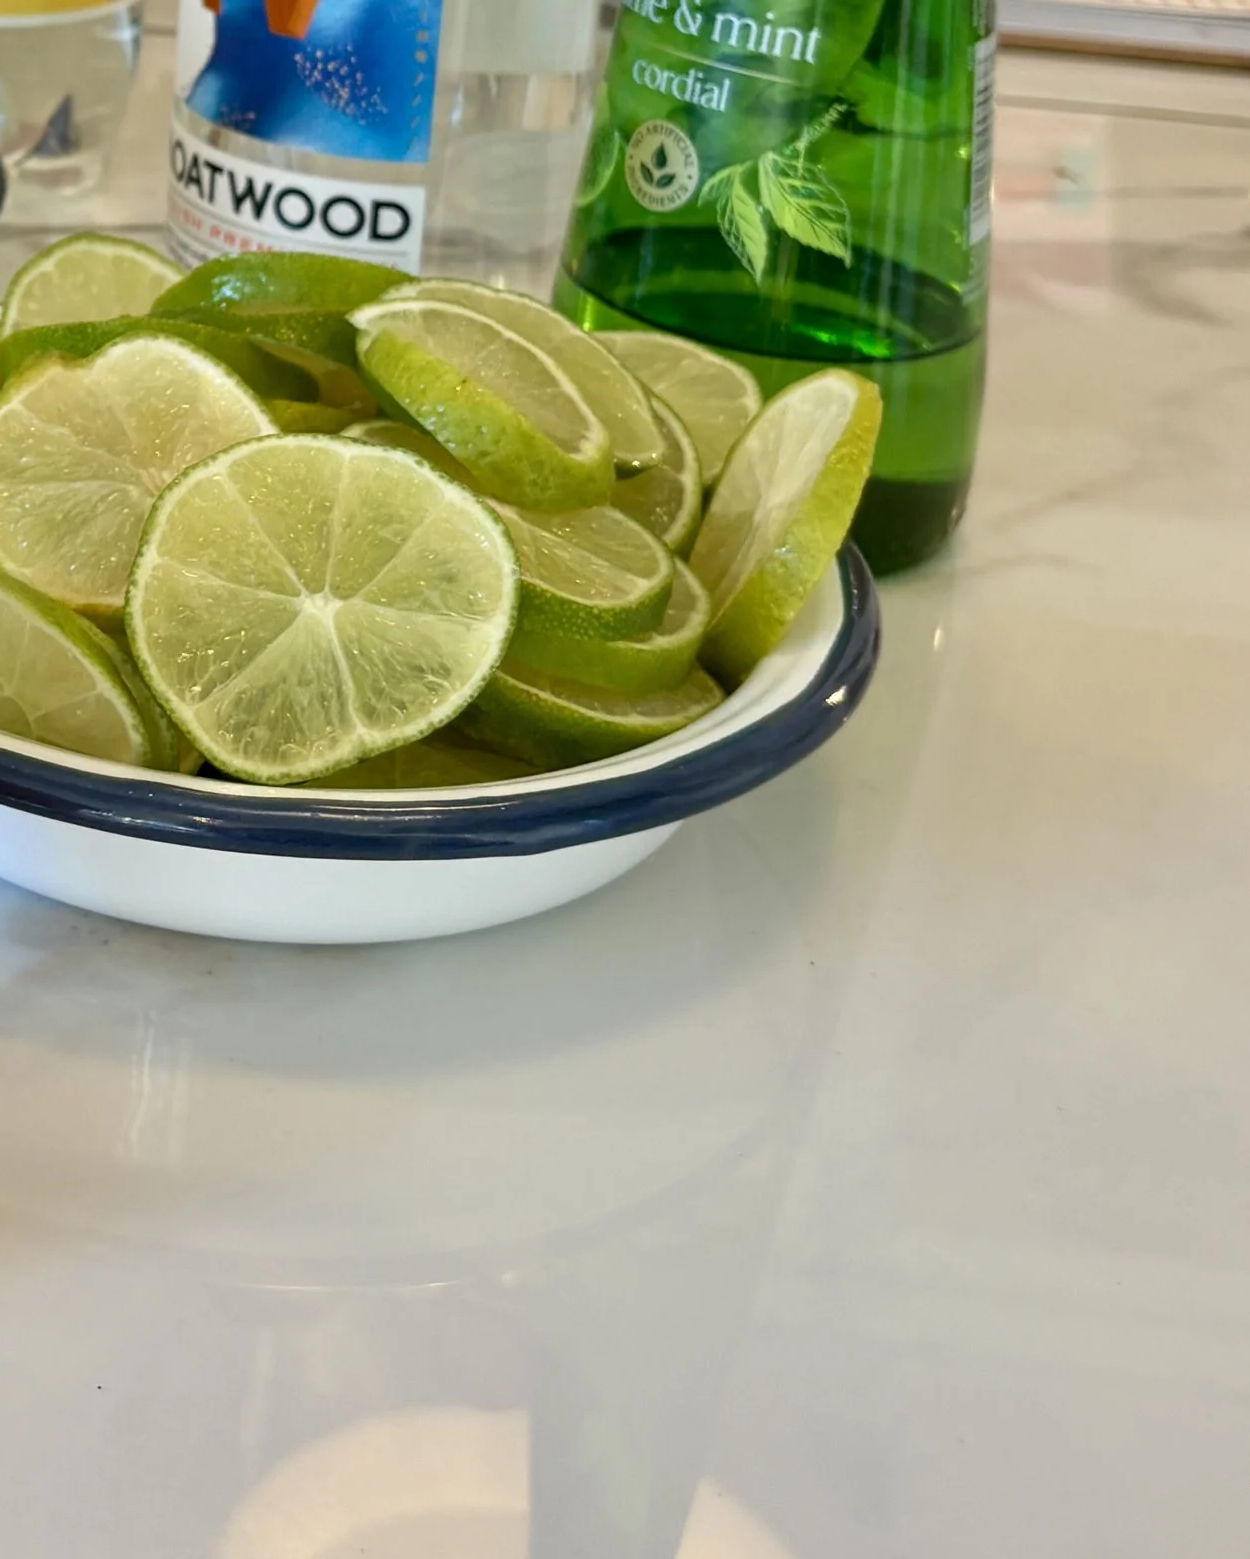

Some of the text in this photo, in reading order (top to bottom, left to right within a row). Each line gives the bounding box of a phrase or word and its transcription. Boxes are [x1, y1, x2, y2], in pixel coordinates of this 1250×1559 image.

[711, 10, 822, 65] mint
[631, 59, 731, 113] cordial
[170, 137, 412, 243] OATWOOD
